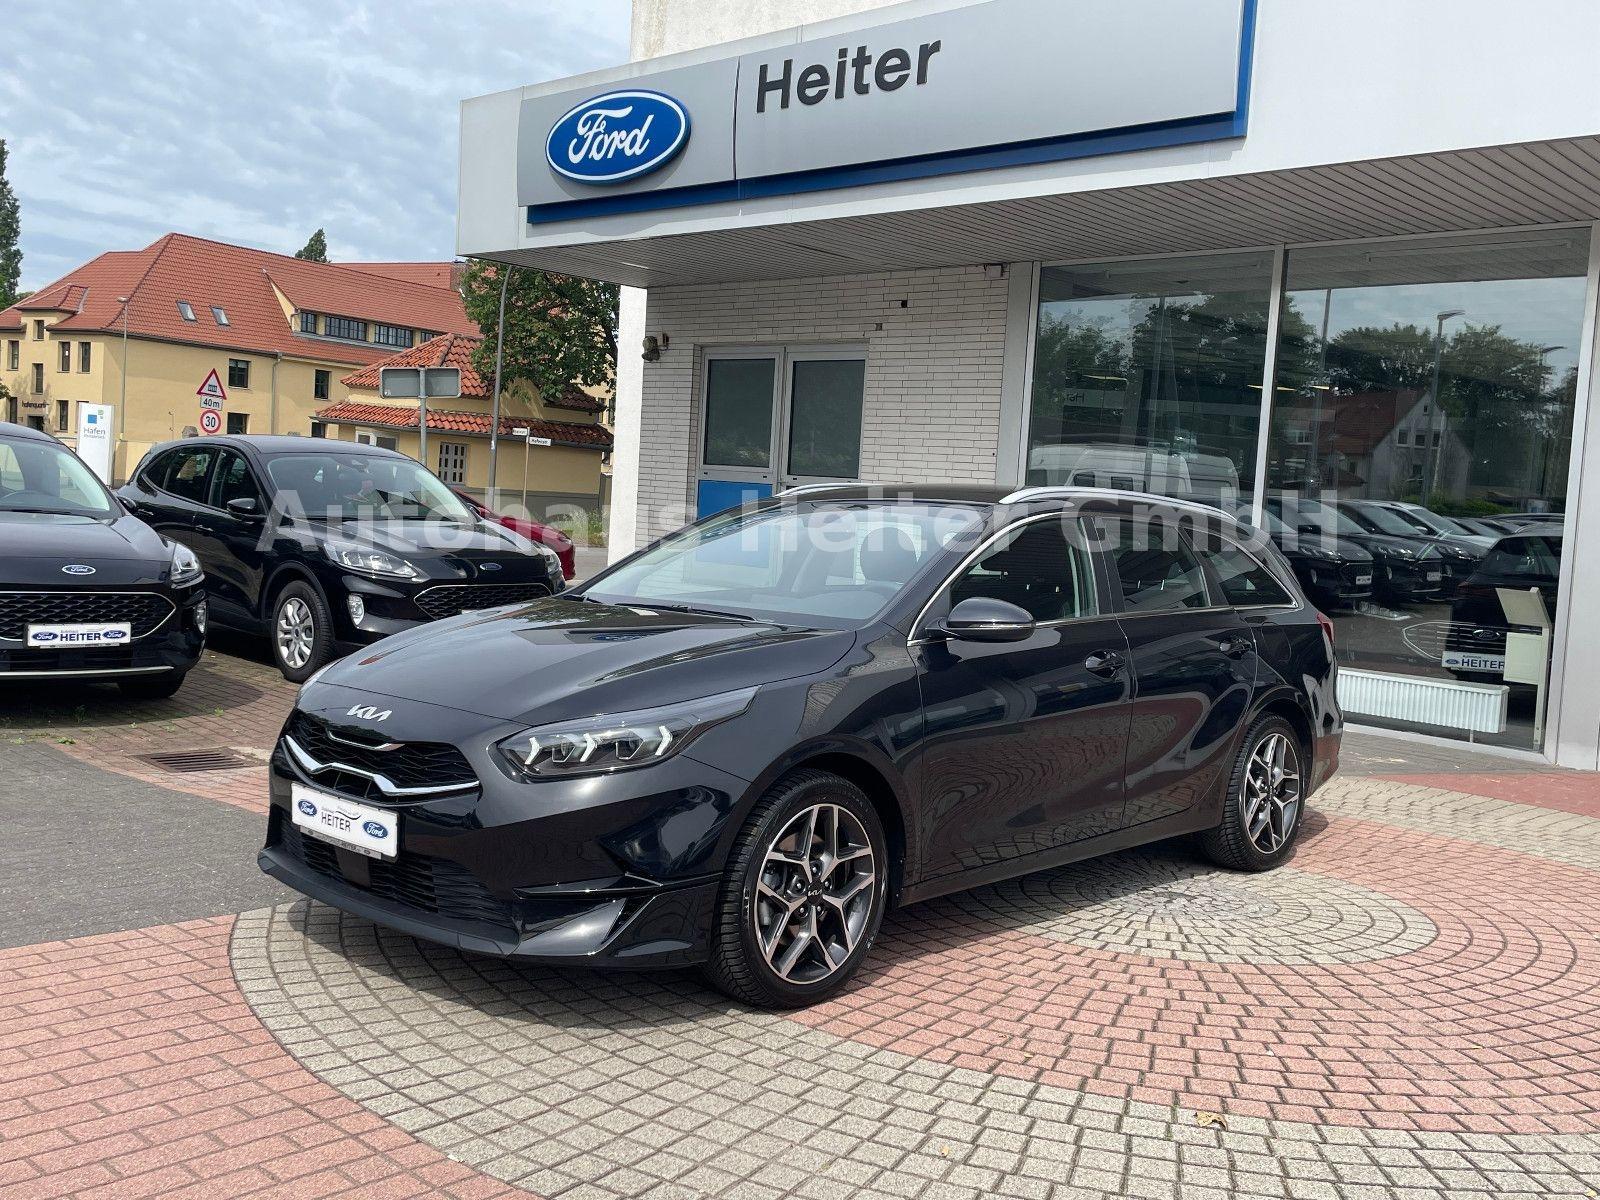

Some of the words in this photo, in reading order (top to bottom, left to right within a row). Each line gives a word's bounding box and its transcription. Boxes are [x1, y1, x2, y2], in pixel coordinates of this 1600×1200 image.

[756, 40, 942, 114] Heiter
[568, 105, 656, 164] Ford
[205, 415, 216, 427] 30
[83, 427, 106, 435] Hafen
[60, 632, 102, 641] HEITER
[320, 811, 351, 832] HEITER
